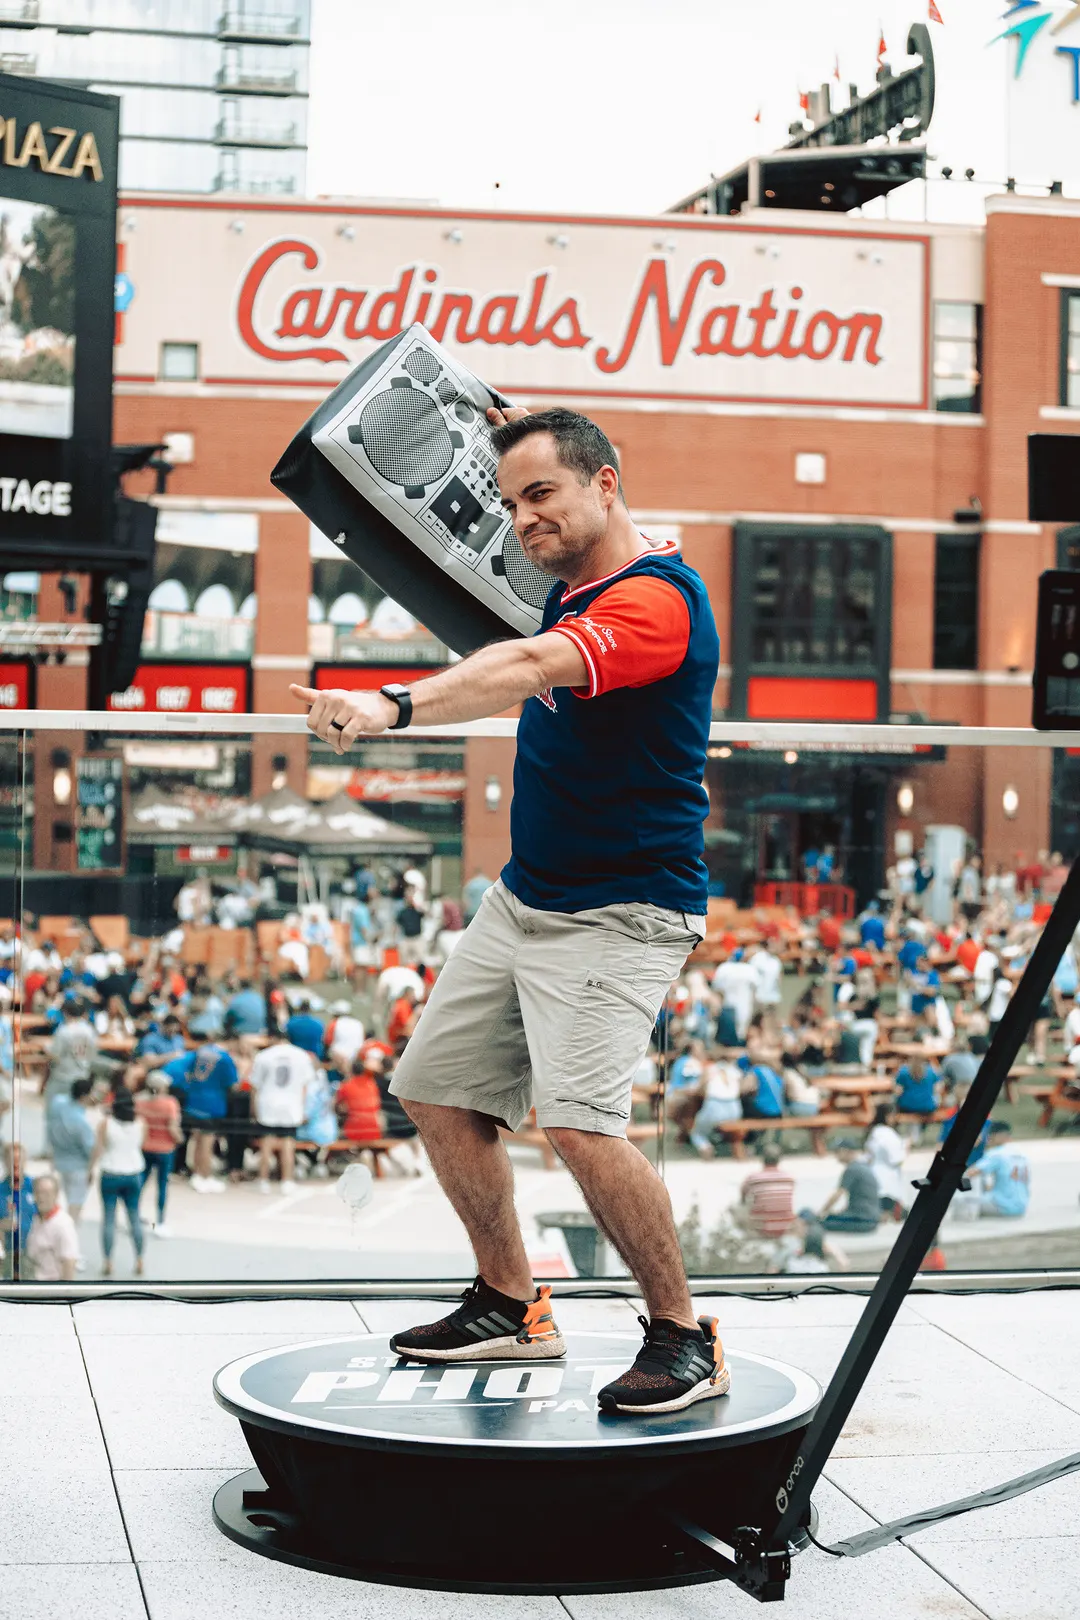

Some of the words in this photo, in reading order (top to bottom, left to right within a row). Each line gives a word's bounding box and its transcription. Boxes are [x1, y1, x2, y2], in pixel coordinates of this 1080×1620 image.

[237, 240, 592, 363] Cardinals
[595, 258, 883, 374] Nation
[289, 1364, 634, 1403] PHOT
[528, 1399, 602, 1413] PA
[786, 1456, 805, 1491] orca
